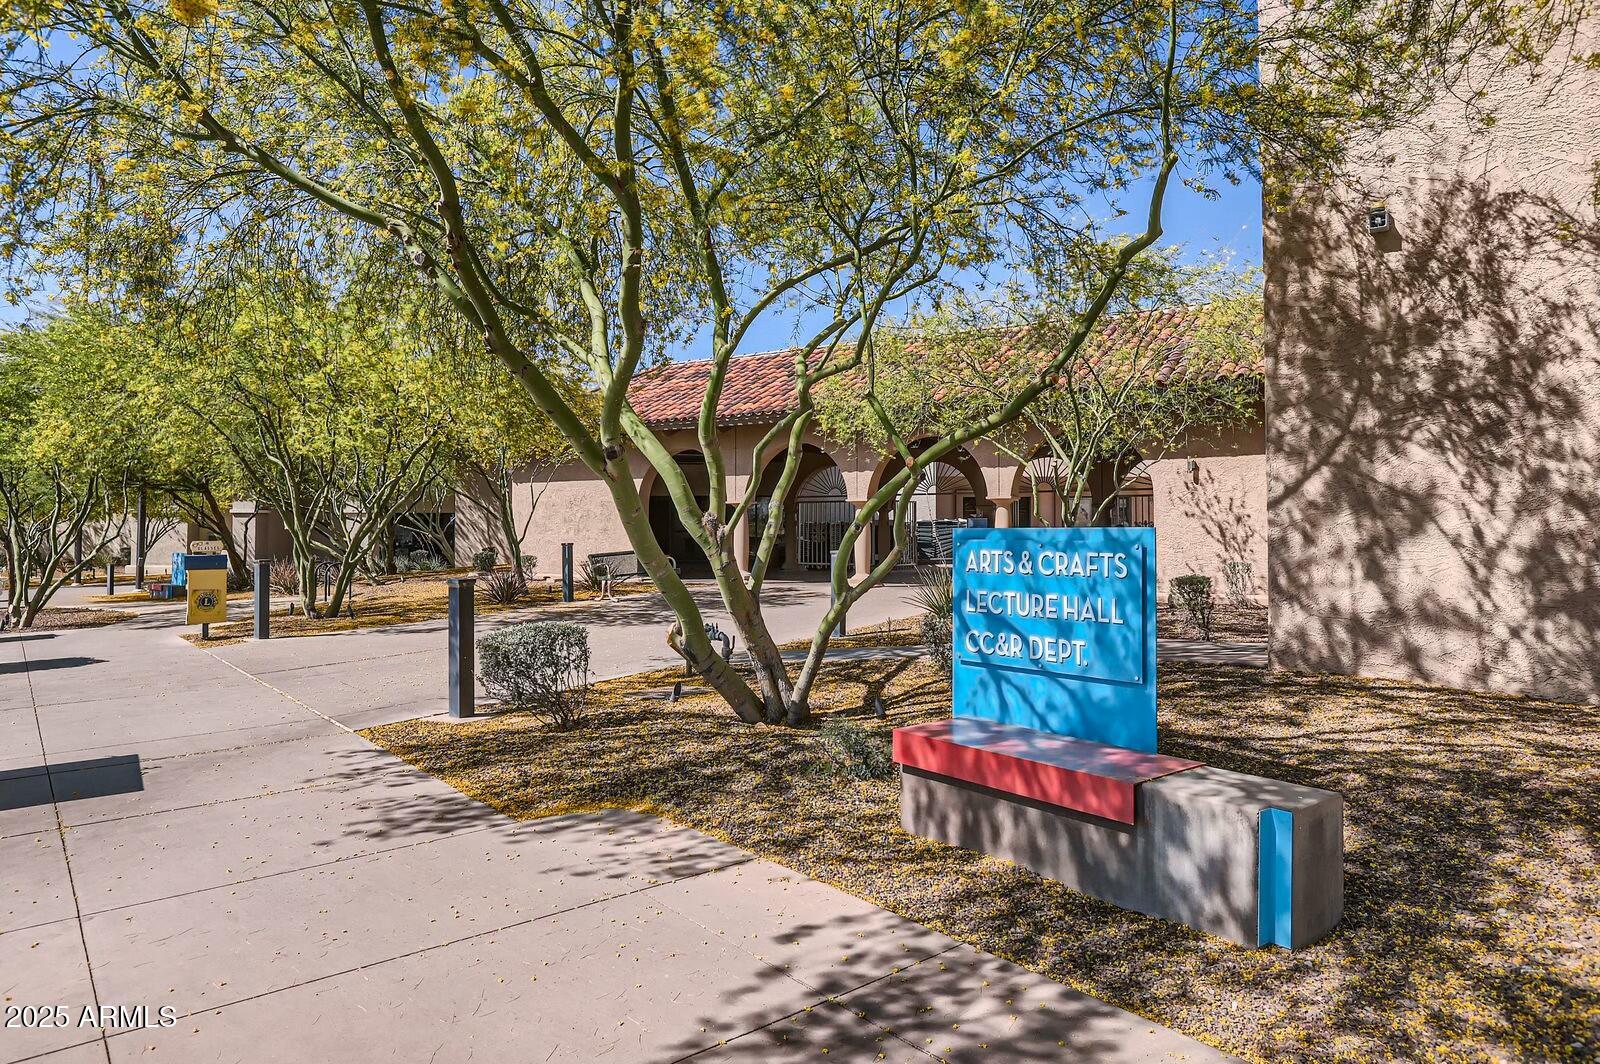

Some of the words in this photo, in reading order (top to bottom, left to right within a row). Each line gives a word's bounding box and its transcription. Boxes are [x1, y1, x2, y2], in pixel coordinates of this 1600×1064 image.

[966, 550, 1014, 574] ARTS
[1018, 551, 1034, 575] &
[1038, 552, 1128, 579] CRAFTS
[965, 590, 1059, 619] LECTURE
[1063, 596, 1124, 624] HALL
[965, 630, 1023, 659] CC&R
[1029, 635, 1089, 666] DEPT.
